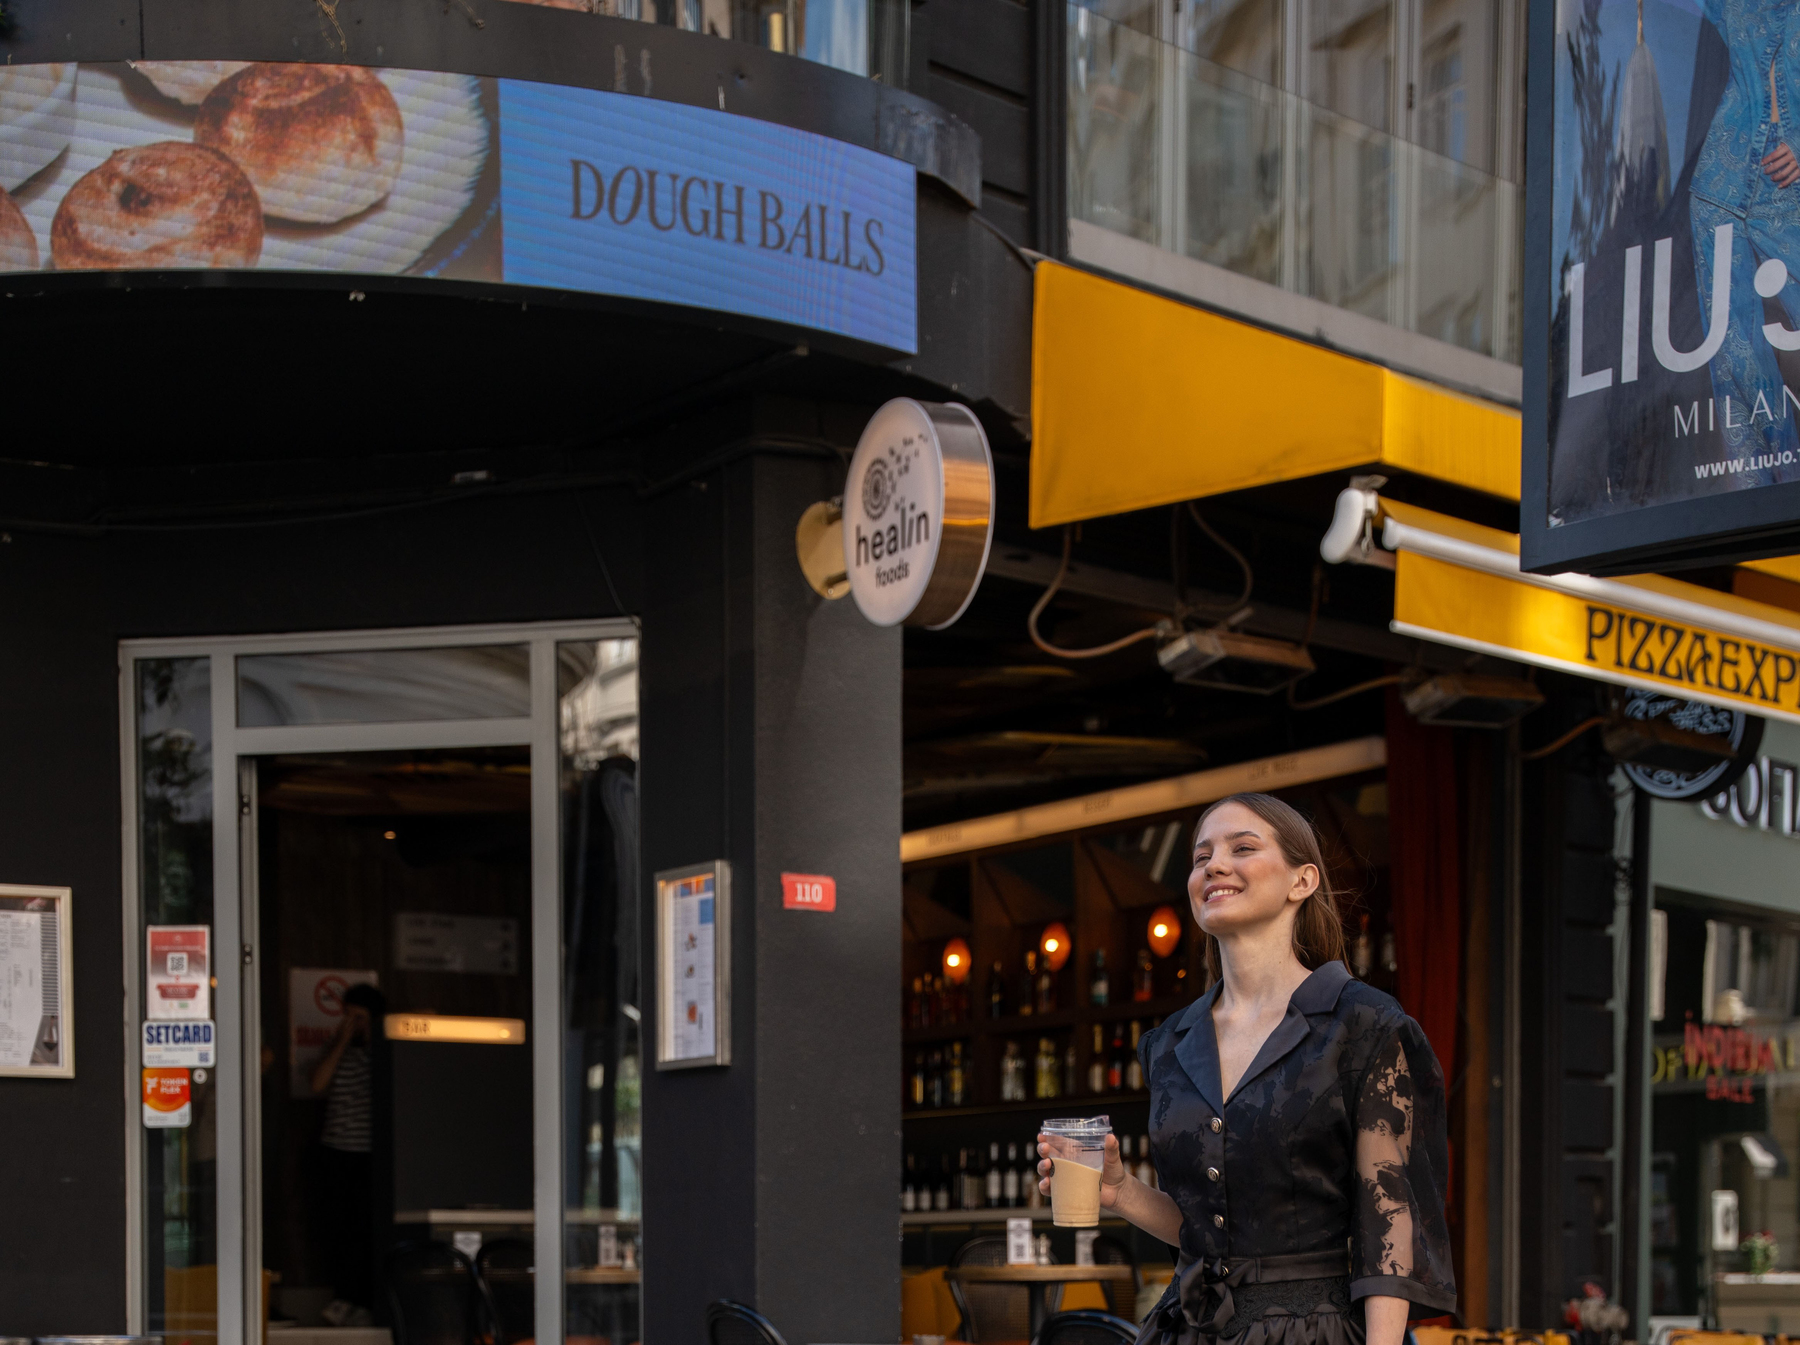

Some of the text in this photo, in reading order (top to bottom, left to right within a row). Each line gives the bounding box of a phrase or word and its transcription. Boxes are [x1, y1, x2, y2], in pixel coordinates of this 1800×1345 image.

[570, 158, 886, 277] DOUGH BALLS
[1694, 448, 1800, 480] WWW.LIUJO.
[855, 501, 930, 568] healin
[875, 557, 911, 589] foods
[1585, 604, 1800, 709] PIZZAEXP
[795, 882, 823, 904] 110
[146, 1024, 212, 1044] SETCARD
